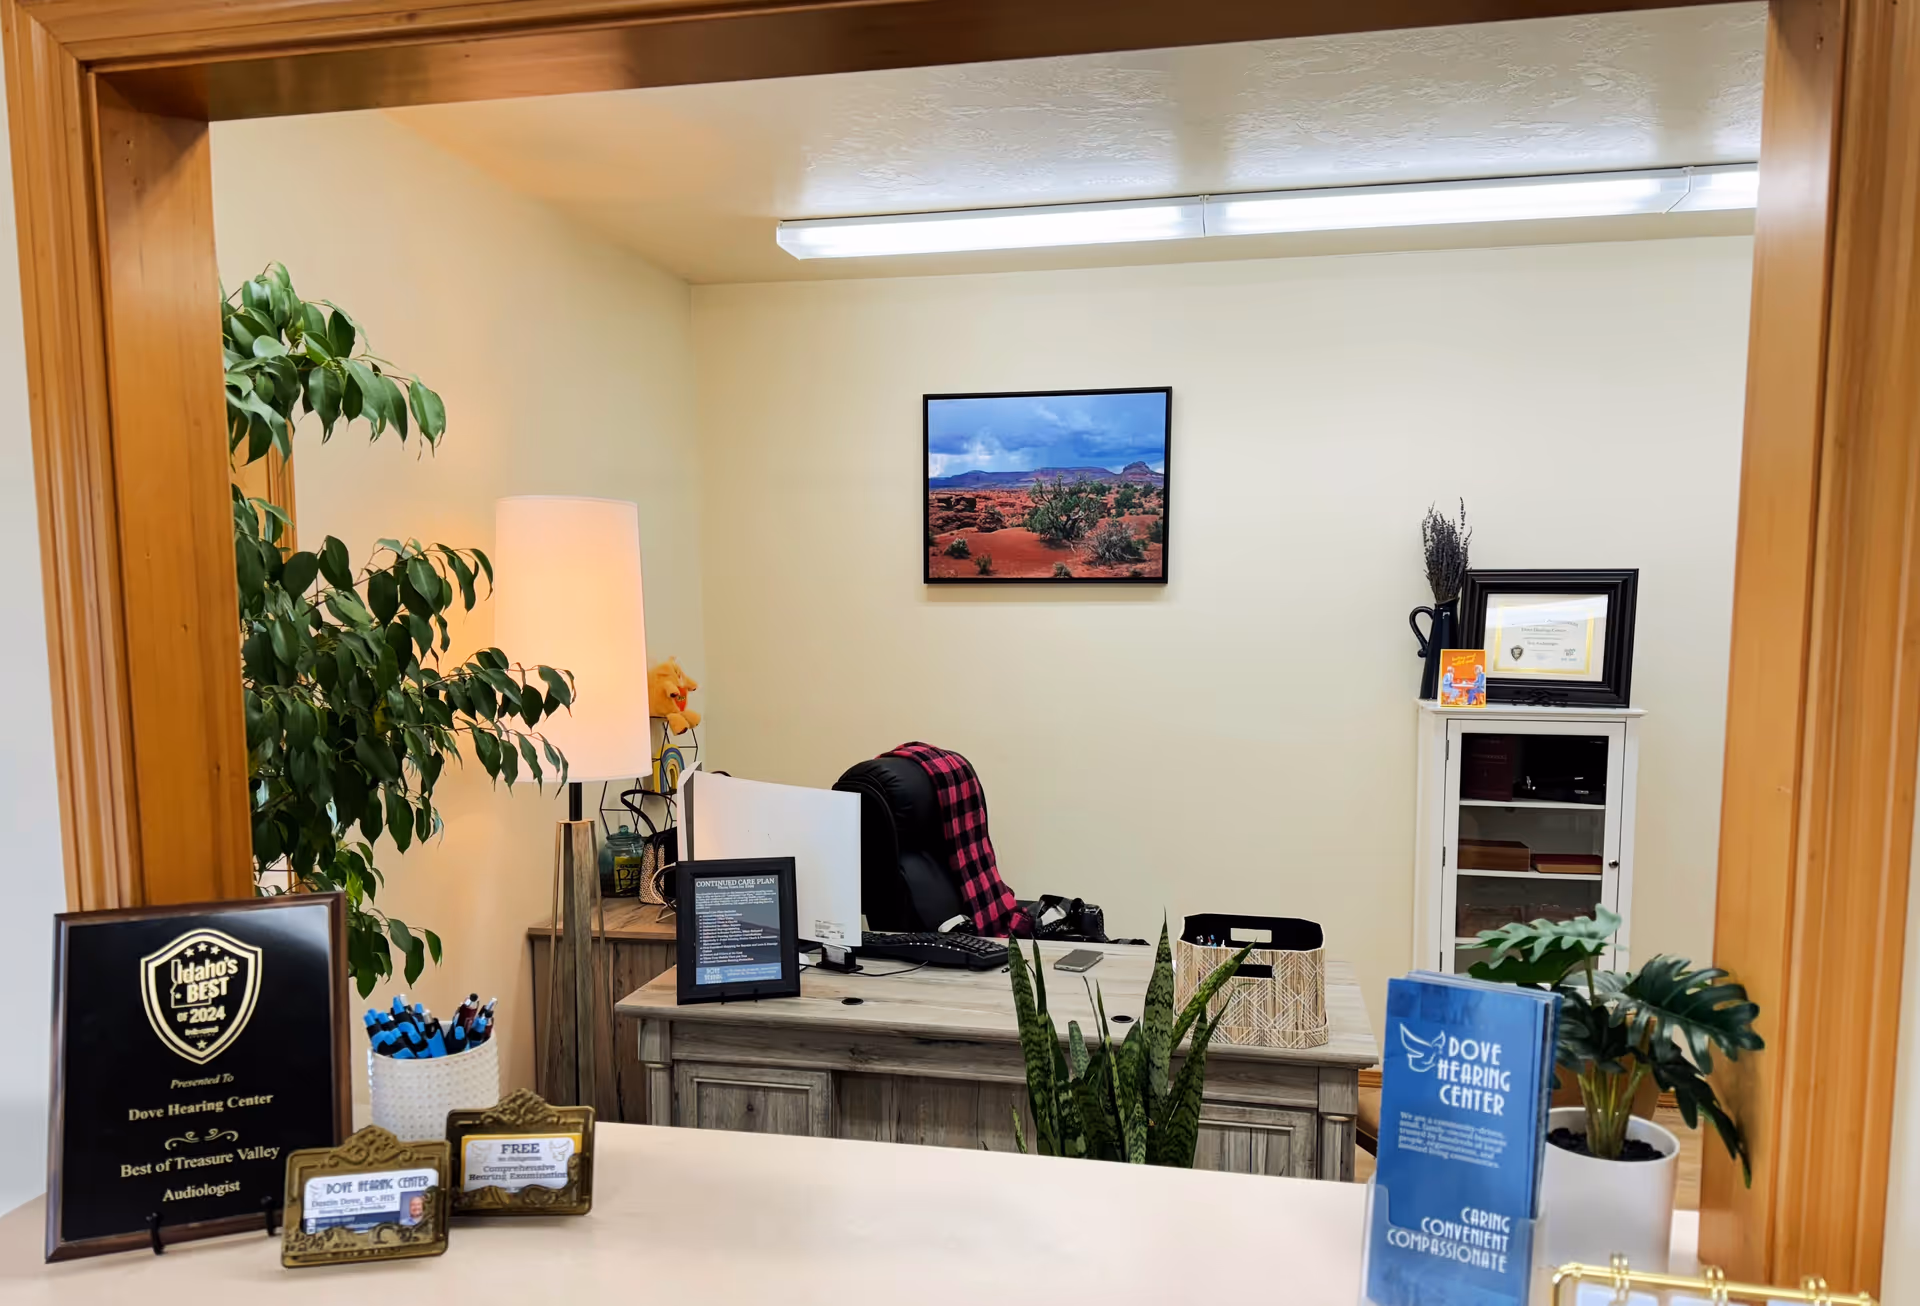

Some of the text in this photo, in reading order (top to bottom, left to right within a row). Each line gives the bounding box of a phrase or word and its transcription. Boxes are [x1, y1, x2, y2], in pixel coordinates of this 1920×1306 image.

[695, 879, 737, 888] CONTINUED
[738, 878, 756, 886] CARE
[757, 877, 775, 885] PLAN
[177, 956, 239, 985] Idaho's
[186, 976, 230, 1004] BEST
[189, 1005, 226, 1024] 2024
[1448, 1036, 1502, 1066] DOVE
[170, 1073, 234, 1089] Presented To
[1437, 1058, 1511, 1093] HEARING
[128, 1094, 274, 1121] Dove Hearing Center
[1439, 1084, 1504, 1116] CENTER
[120, 1145, 280, 1178] Best of Treasure Valley
[501, 1143, 540, 1154] FREE
[468, 1173, 508, 1181] Hearing
[483, 1164, 556, 1174] Comprehensive
[162, 1180, 241, 1202] Audiologist
[326, 1175, 429, 1195] DOVE HEARING CENTER
[1421, 1216, 1509, 1252] CONVENIENT
[1461, 1207, 1511, 1234] CARING
[1387, 1228, 1508, 1274] COMPASSIONATE
